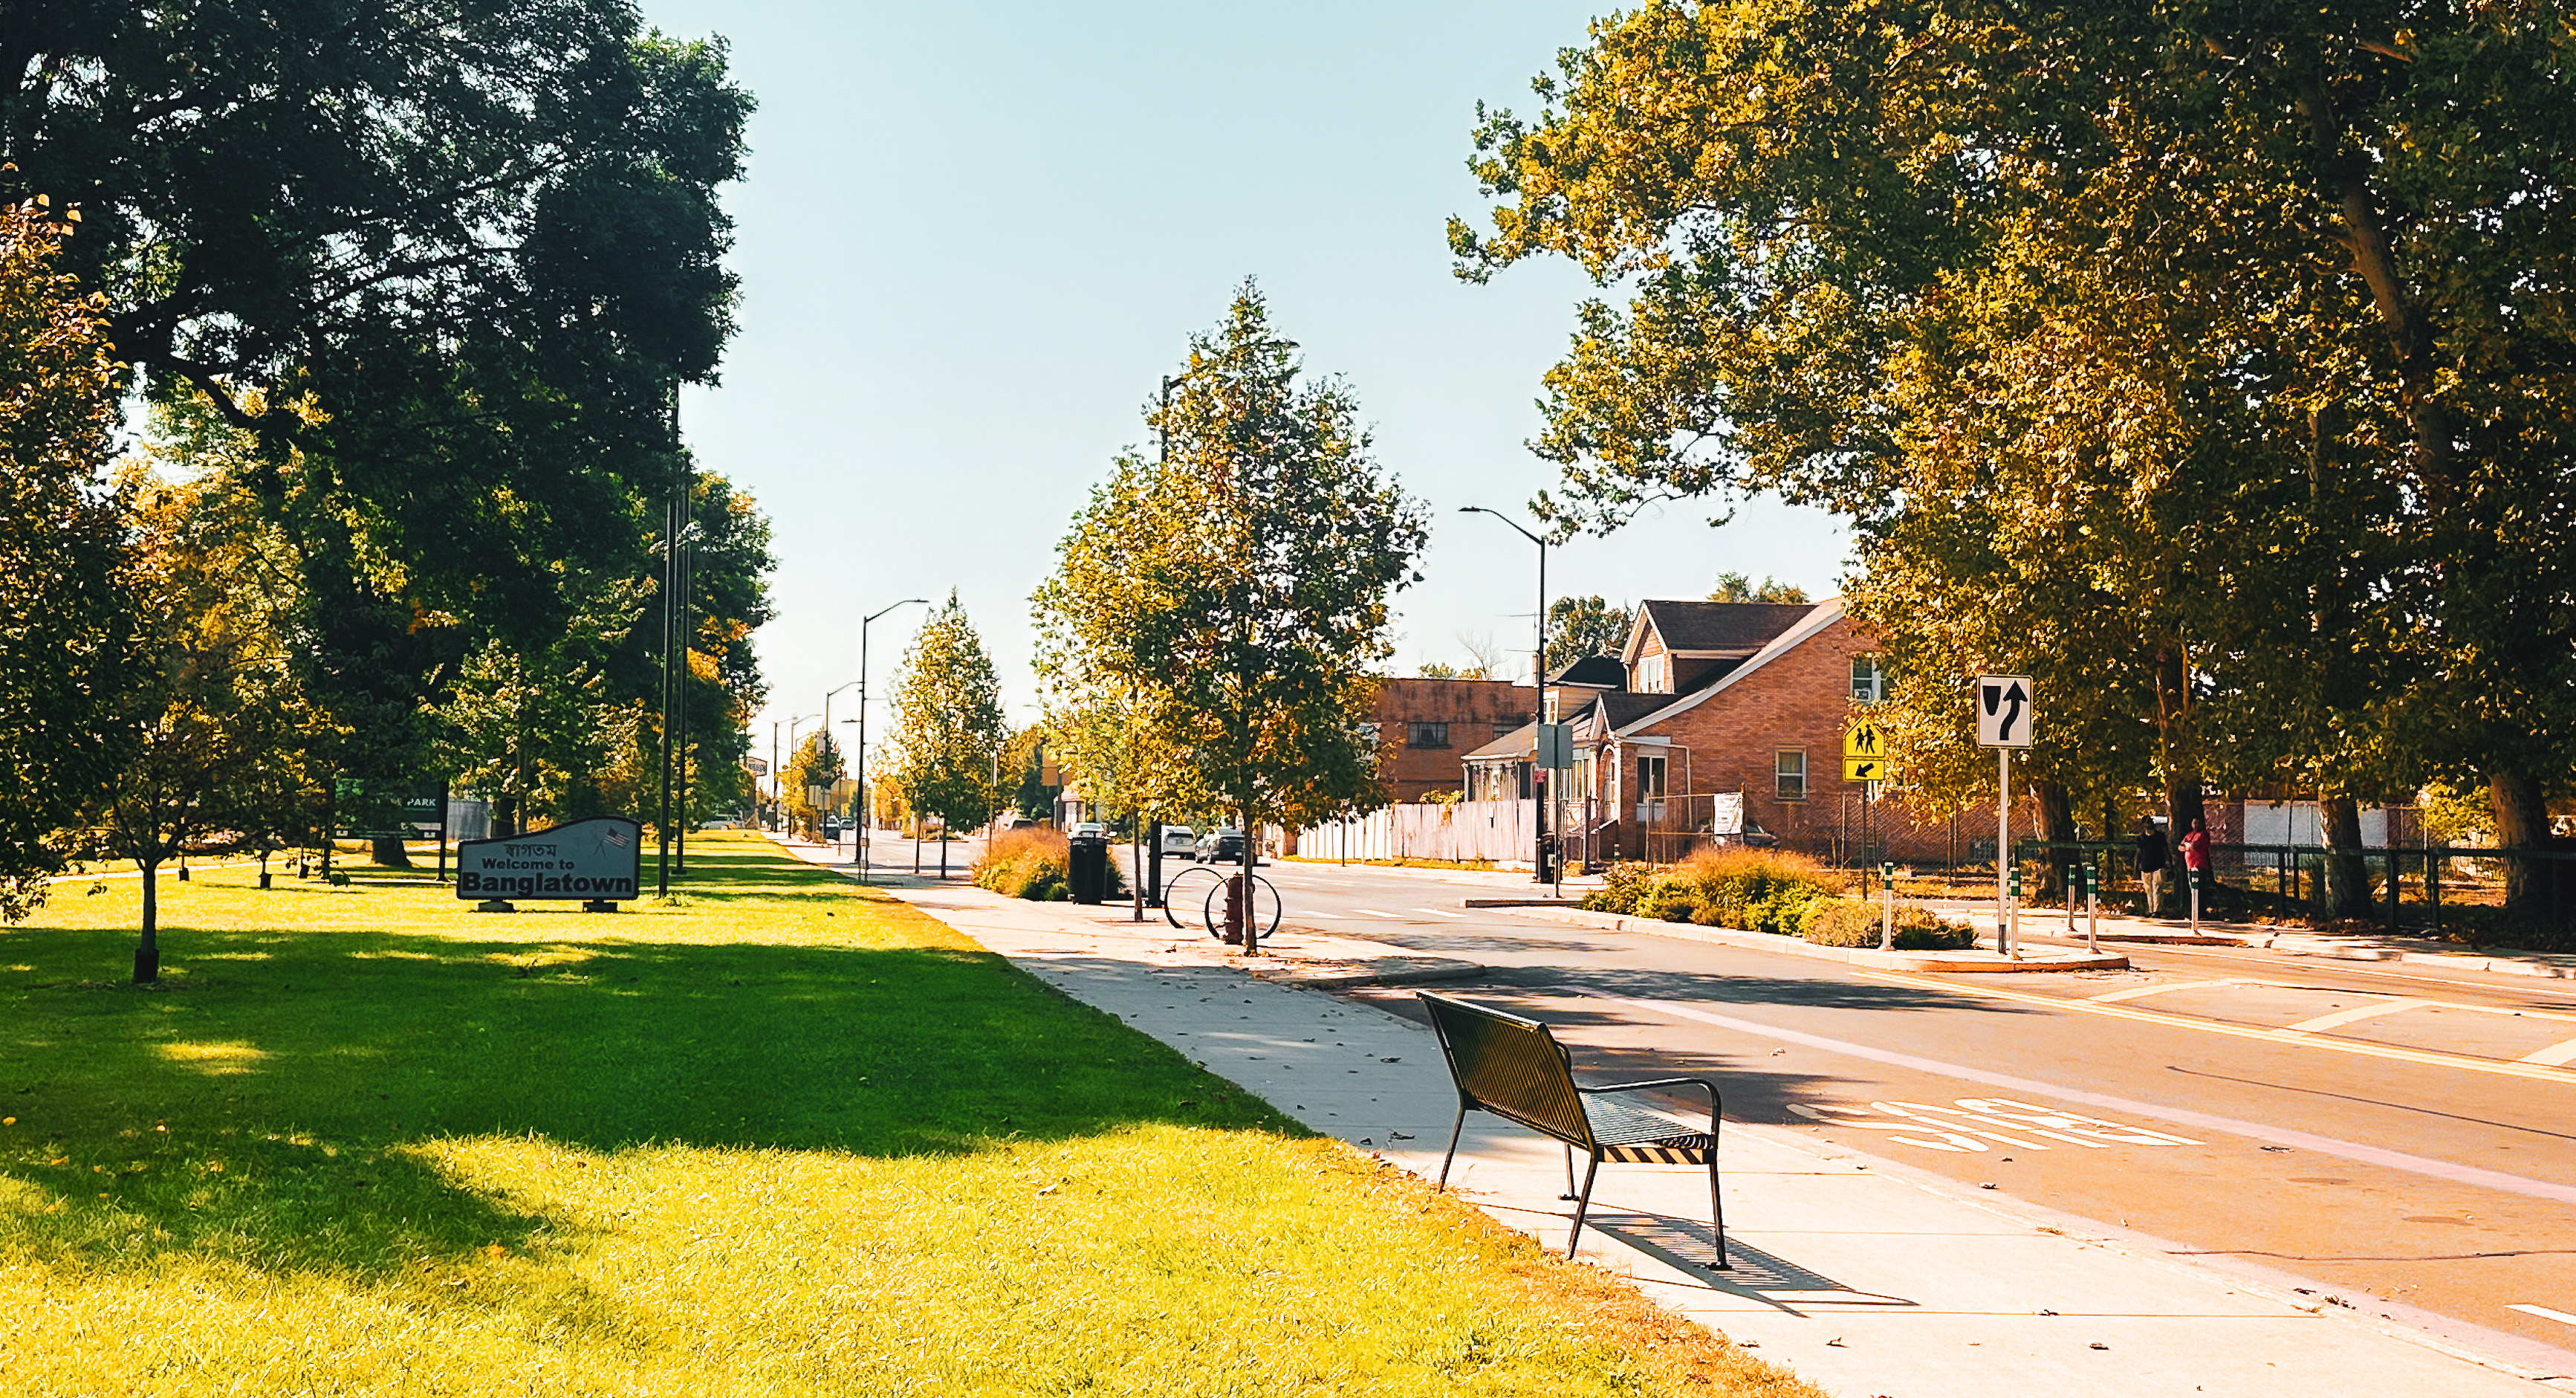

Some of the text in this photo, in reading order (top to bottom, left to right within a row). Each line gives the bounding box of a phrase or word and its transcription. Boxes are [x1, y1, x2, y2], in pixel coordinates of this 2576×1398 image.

[504, 844, 557, 857] স্বাগতম
[482, 858, 575, 870] Welcome to
[462, 872, 632, 896] Banglatown
